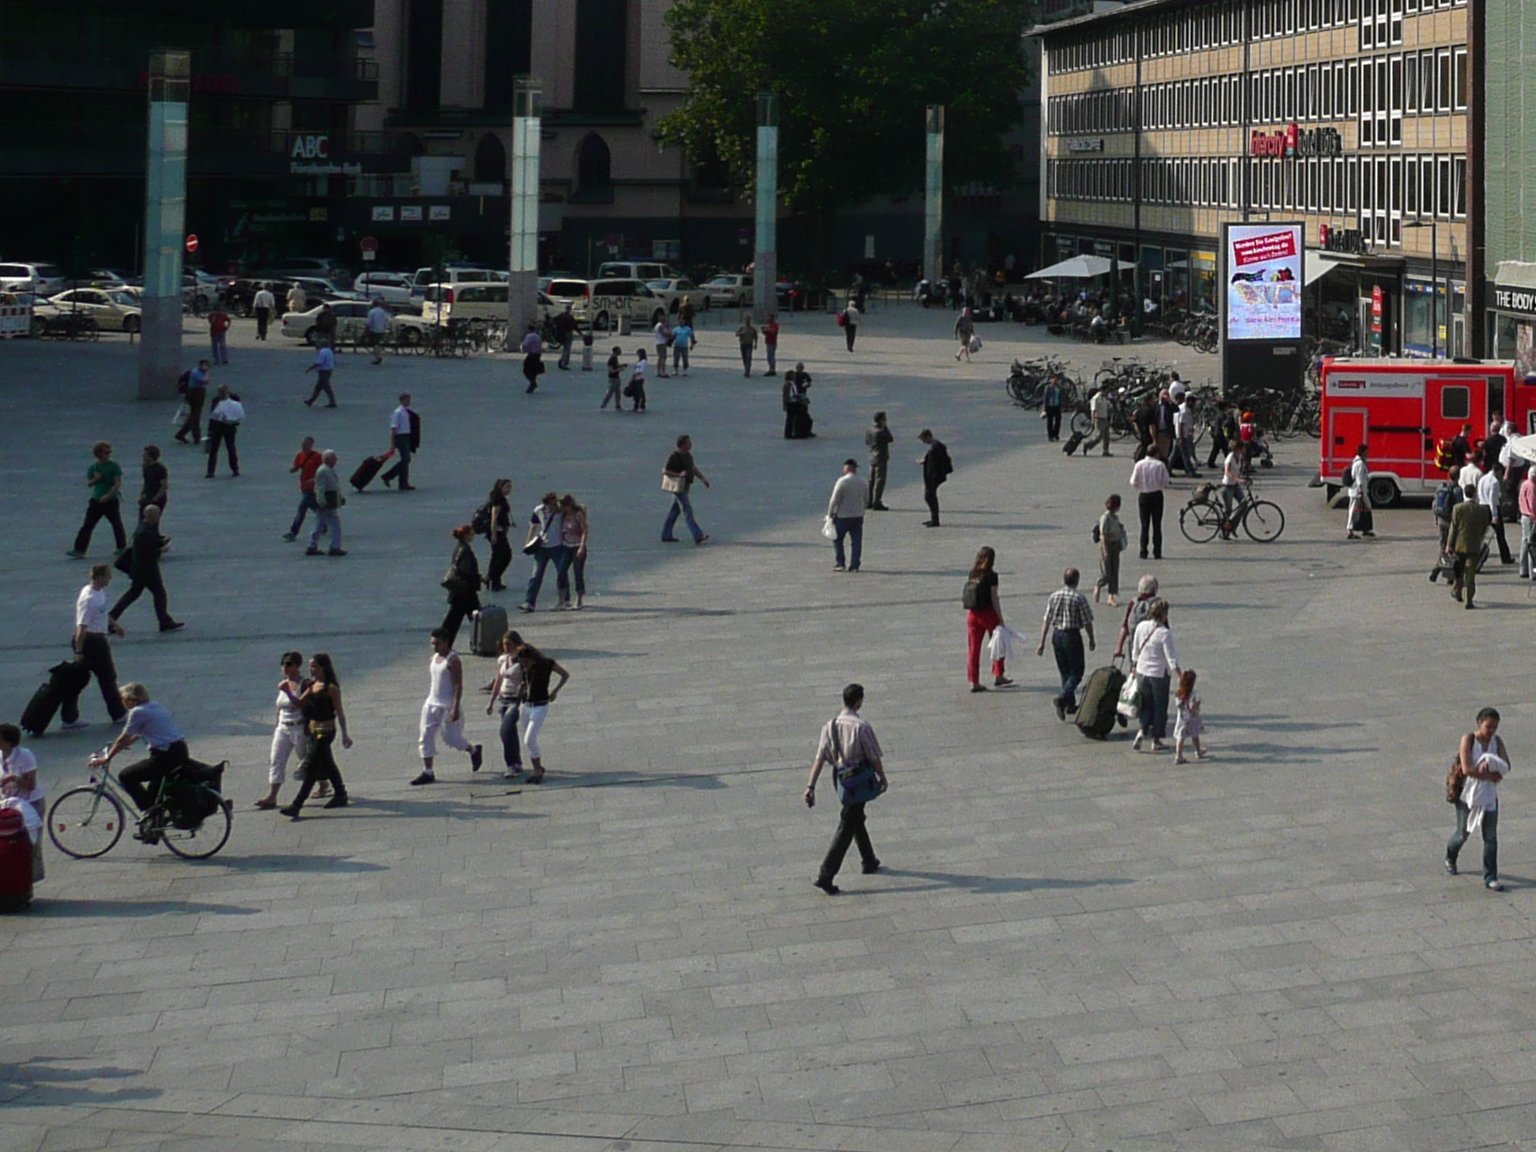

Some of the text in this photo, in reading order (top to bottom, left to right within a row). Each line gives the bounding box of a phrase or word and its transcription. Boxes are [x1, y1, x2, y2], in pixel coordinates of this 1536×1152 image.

[292, 135, 328, 158] ABC
[1495, 290, 1512, 307] THE
[1512, 293, 1534, 311] BODY
